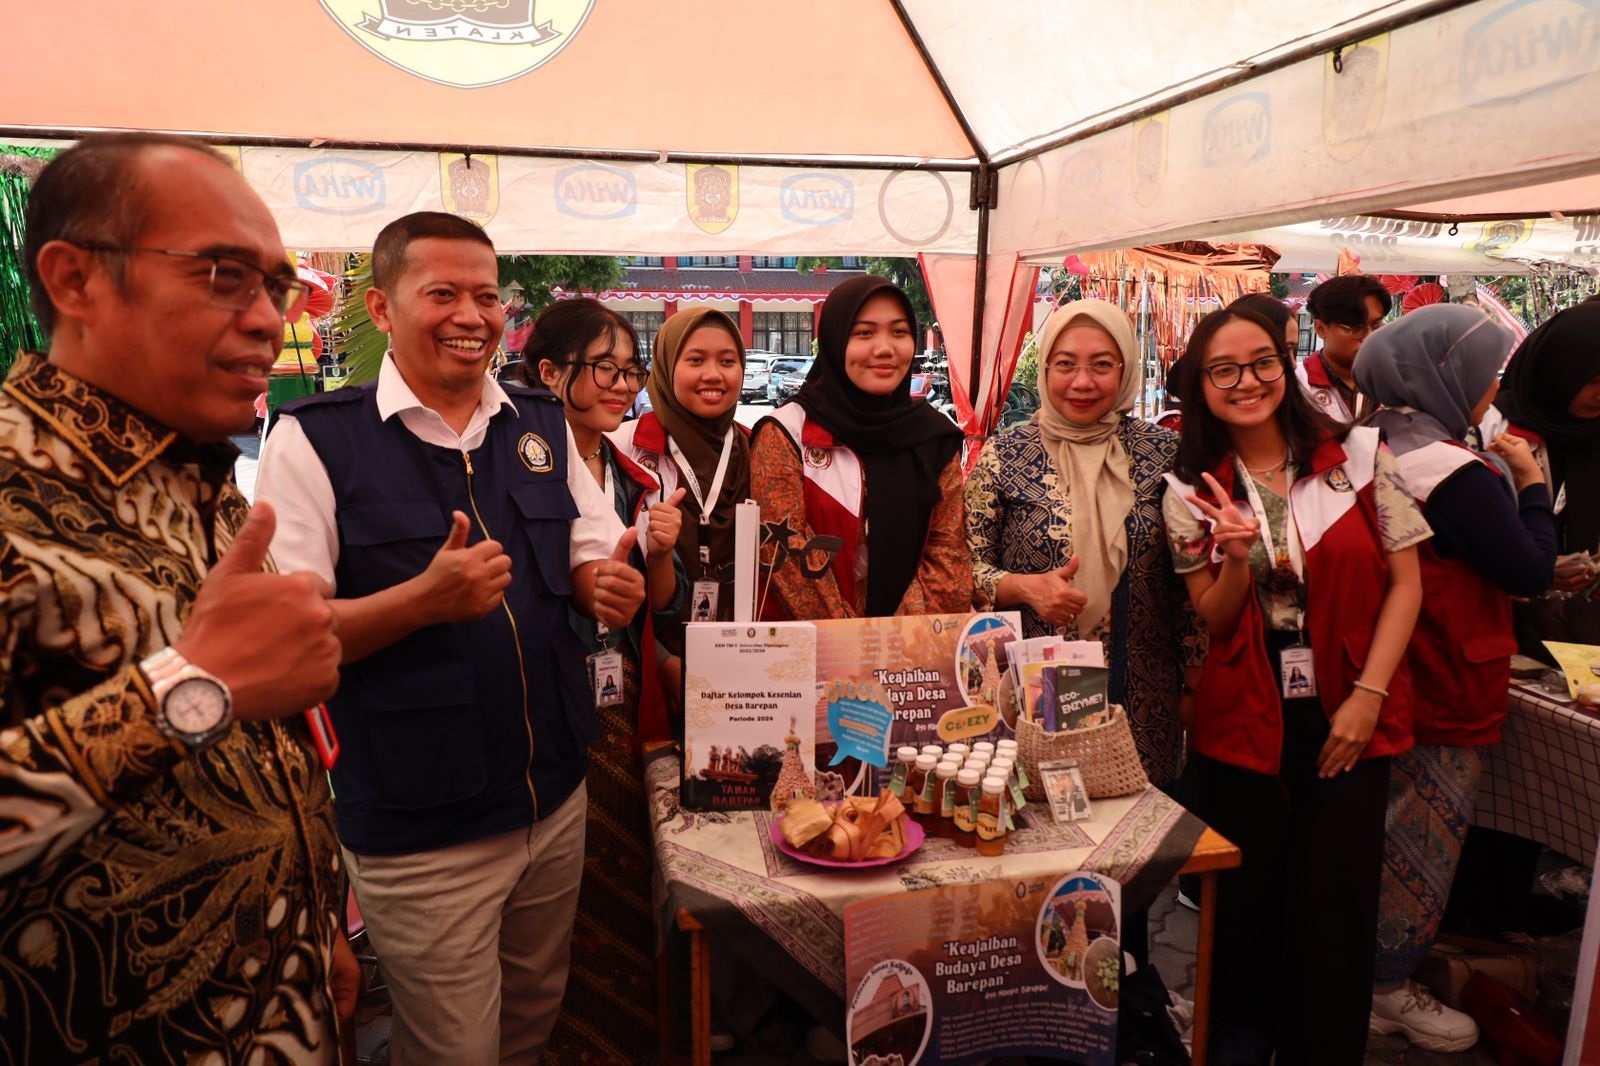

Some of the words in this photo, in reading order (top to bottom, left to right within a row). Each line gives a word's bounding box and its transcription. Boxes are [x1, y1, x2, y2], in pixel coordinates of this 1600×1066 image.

[701, 692, 726, 700] Daftar
[728, 691, 765, 699] Kelompok
[917, 687, 946, 700] Desa
[1059, 691, 1080, 702] ECO-
[1061, 693, 1103, 714] ENZYME?
[935, 960, 987, 976] Budaya
[990, 954, 1022, 970] Desa
